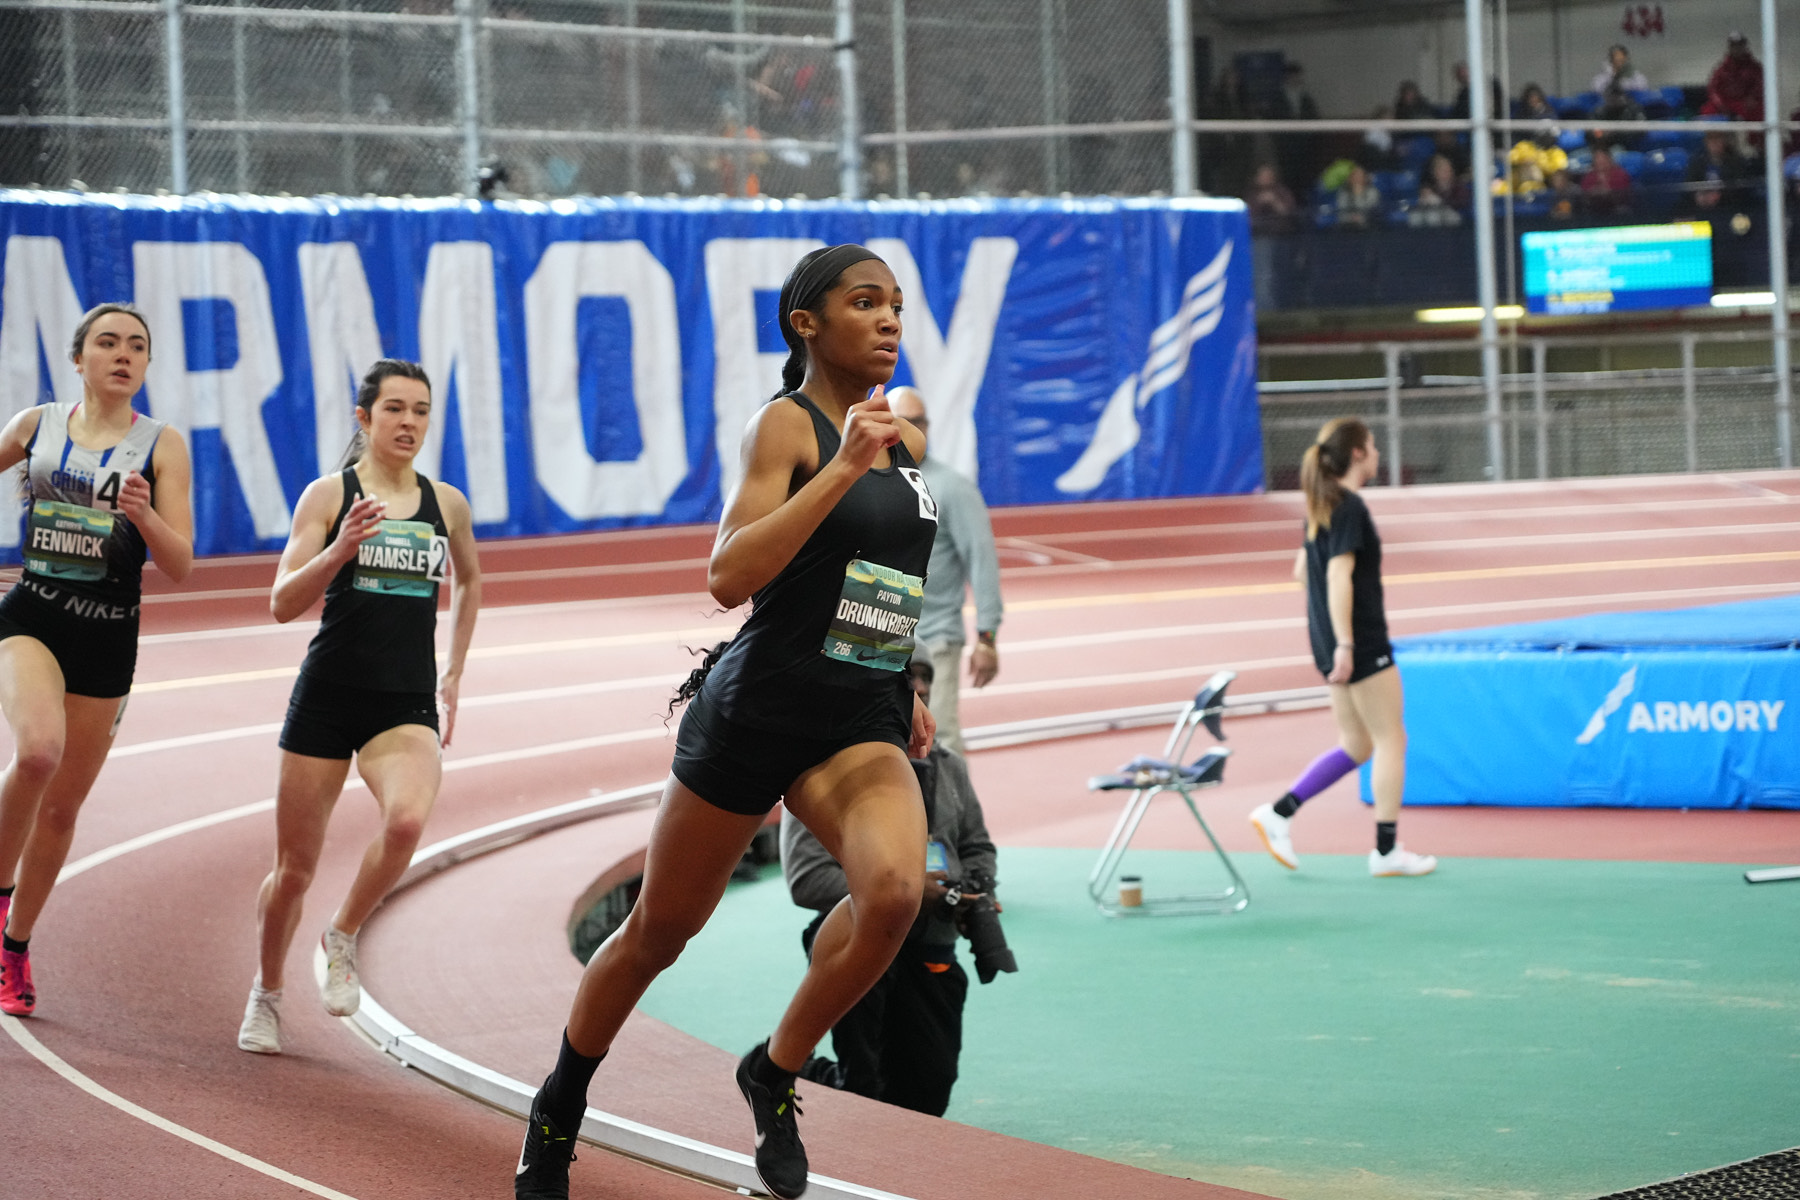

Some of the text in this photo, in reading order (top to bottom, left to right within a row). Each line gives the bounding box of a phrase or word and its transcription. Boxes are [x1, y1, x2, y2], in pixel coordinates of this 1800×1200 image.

[97, 471, 121, 510] 4
[32, 527, 104, 558] FENWICK
[433, 540, 446, 578] 2
[64, 595, 125, 619] NIKE
[876, 589, 903, 606] PAYTON
[836, 599, 918, 638] DRUMWRIGHT
[833, 641, 853, 657] 266
[1627, 699, 1785, 733] ARMORY
